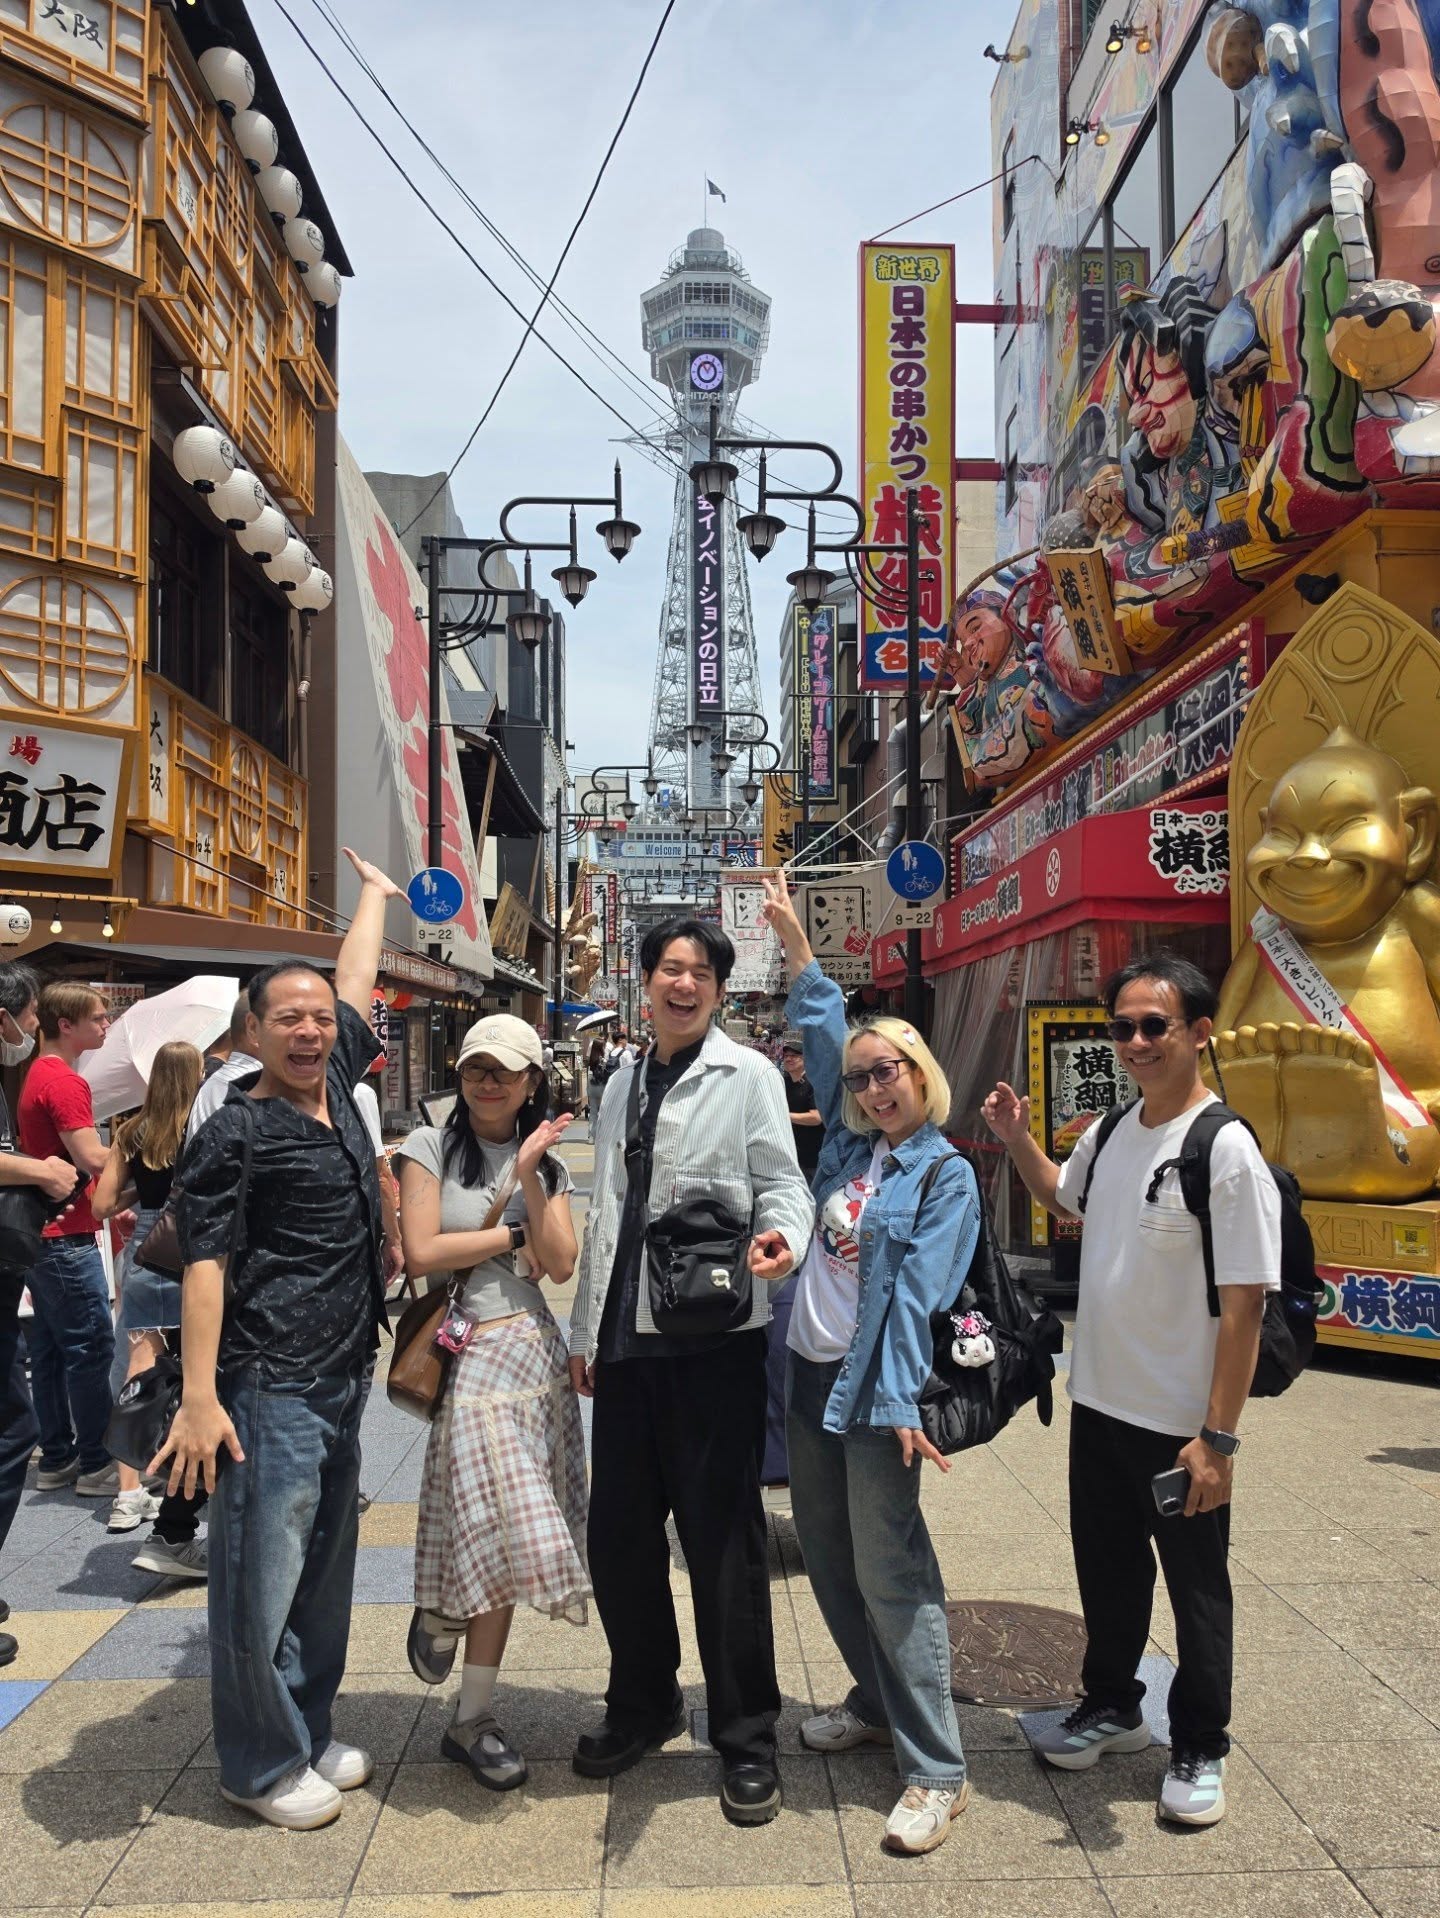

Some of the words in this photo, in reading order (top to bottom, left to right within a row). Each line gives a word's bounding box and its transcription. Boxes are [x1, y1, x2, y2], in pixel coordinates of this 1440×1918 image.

[40, 0, 104, 51] 大阪
[876, 256, 940, 281] 新世界
[687, 391, 729, 401] HITACHI
[889, 285, 928, 482] 日本一の串かつ
[873, 484, 943, 633] 横綱
[879, 640, 944, 671] 名門
[1173, 669, 1234, 781] 横綱
[9, 735, 44, 766] 場
[645, 844, 682, 856] Welcome
[1177, 876, 1223, 891] よこづな
[371, 998, 388, 1058] おで
[1062, 1063, 1073, 1103] よこづな
[1072, 1045, 1116, 1112] 横綱
[1341, 1275, 1440, 1334] 横綱
